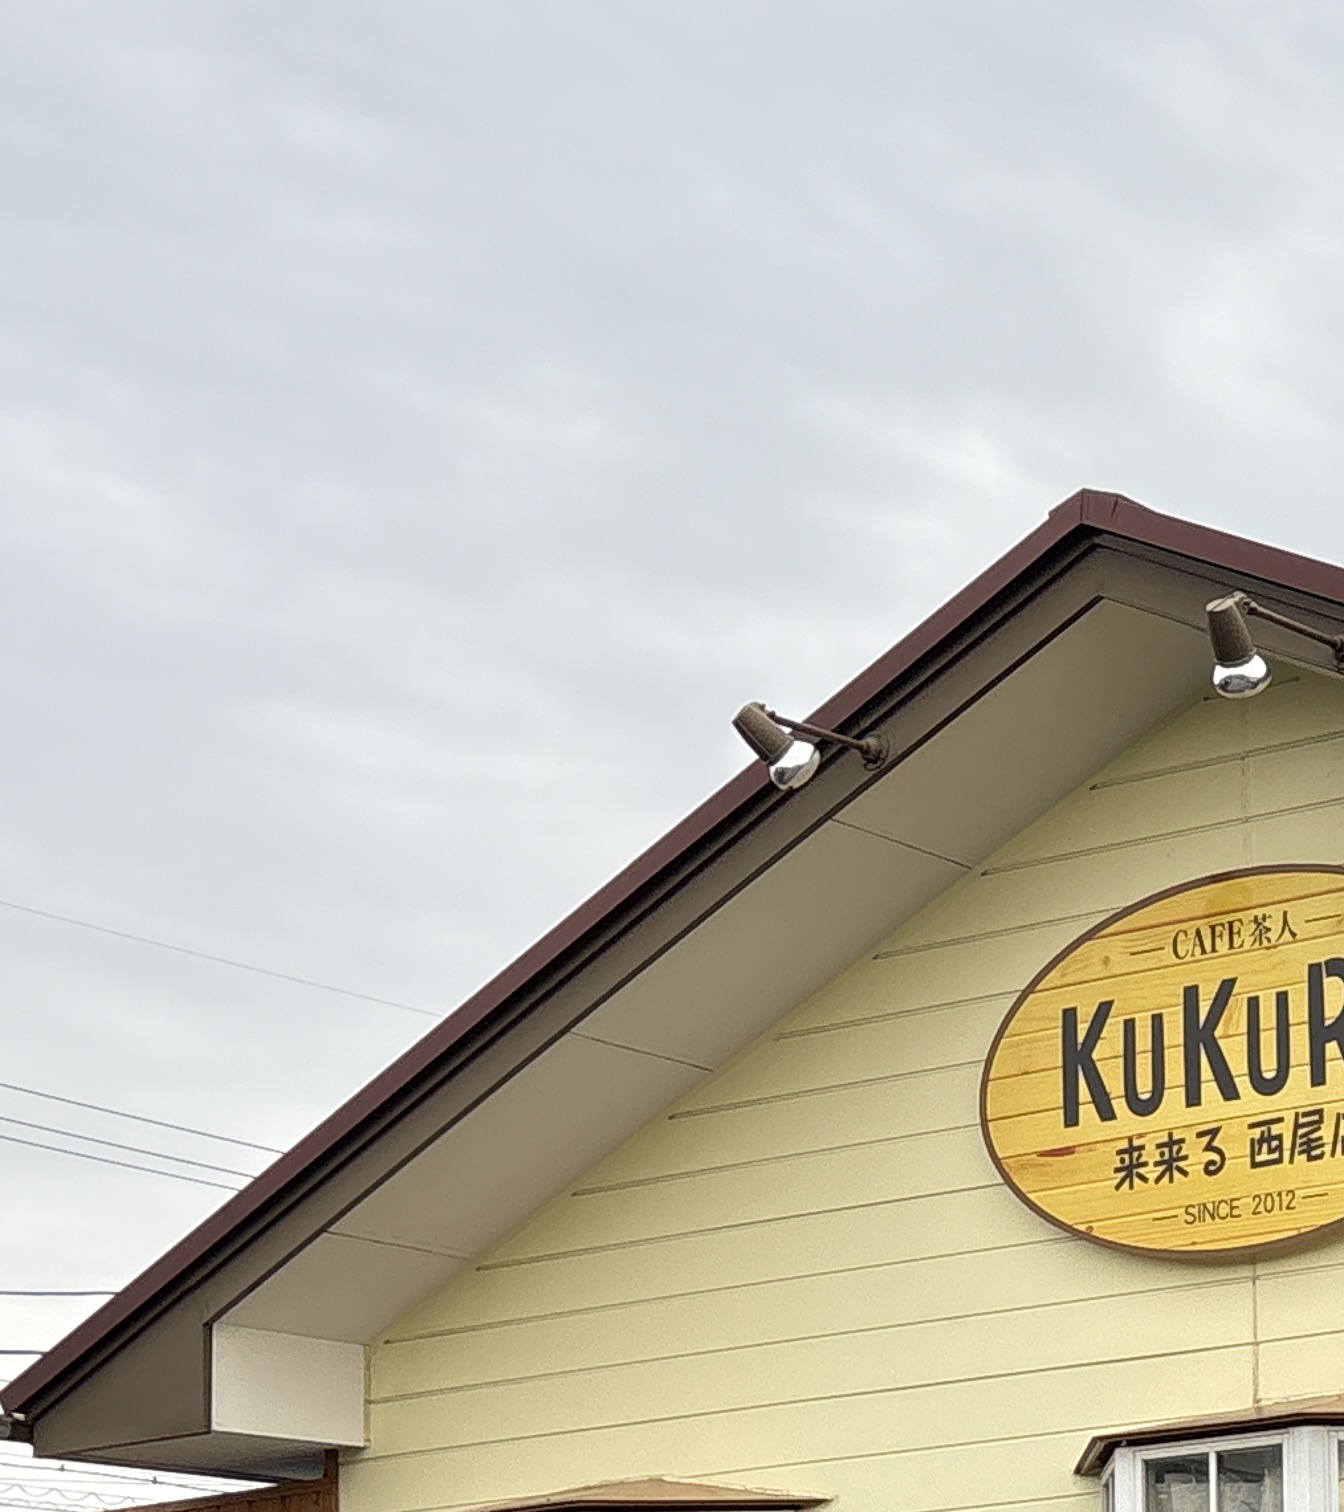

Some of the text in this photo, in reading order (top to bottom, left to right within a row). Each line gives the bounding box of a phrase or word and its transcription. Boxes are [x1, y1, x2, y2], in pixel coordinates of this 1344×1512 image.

[1114, 1126, 1227, 1191] 来来る
[1183, 1190, 1298, 1225] SINCE 2012
